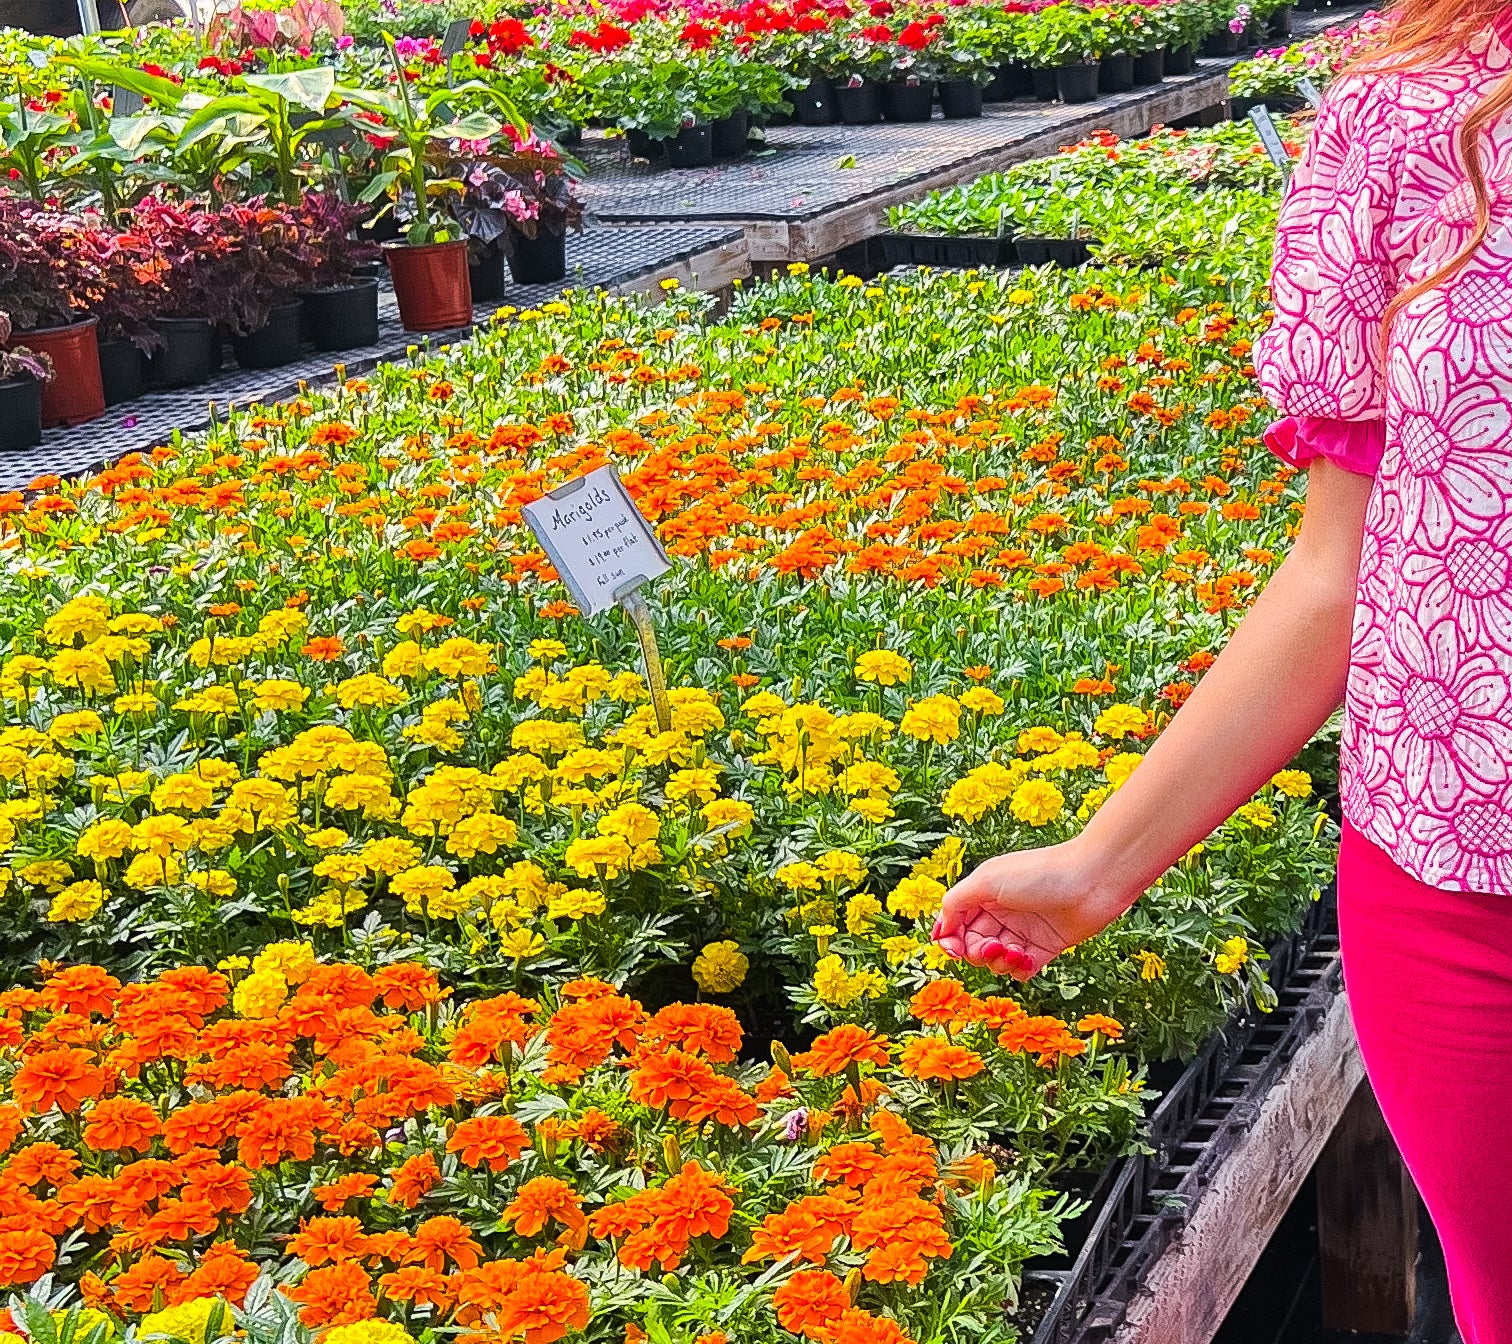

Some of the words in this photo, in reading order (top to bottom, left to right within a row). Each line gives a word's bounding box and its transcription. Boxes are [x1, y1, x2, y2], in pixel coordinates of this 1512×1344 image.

[552, 487, 611, 531] Marigolds
[604, 526, 614, 539] per
[613, 546, 624, 558] per
[623, 533, 638, 548] flat
